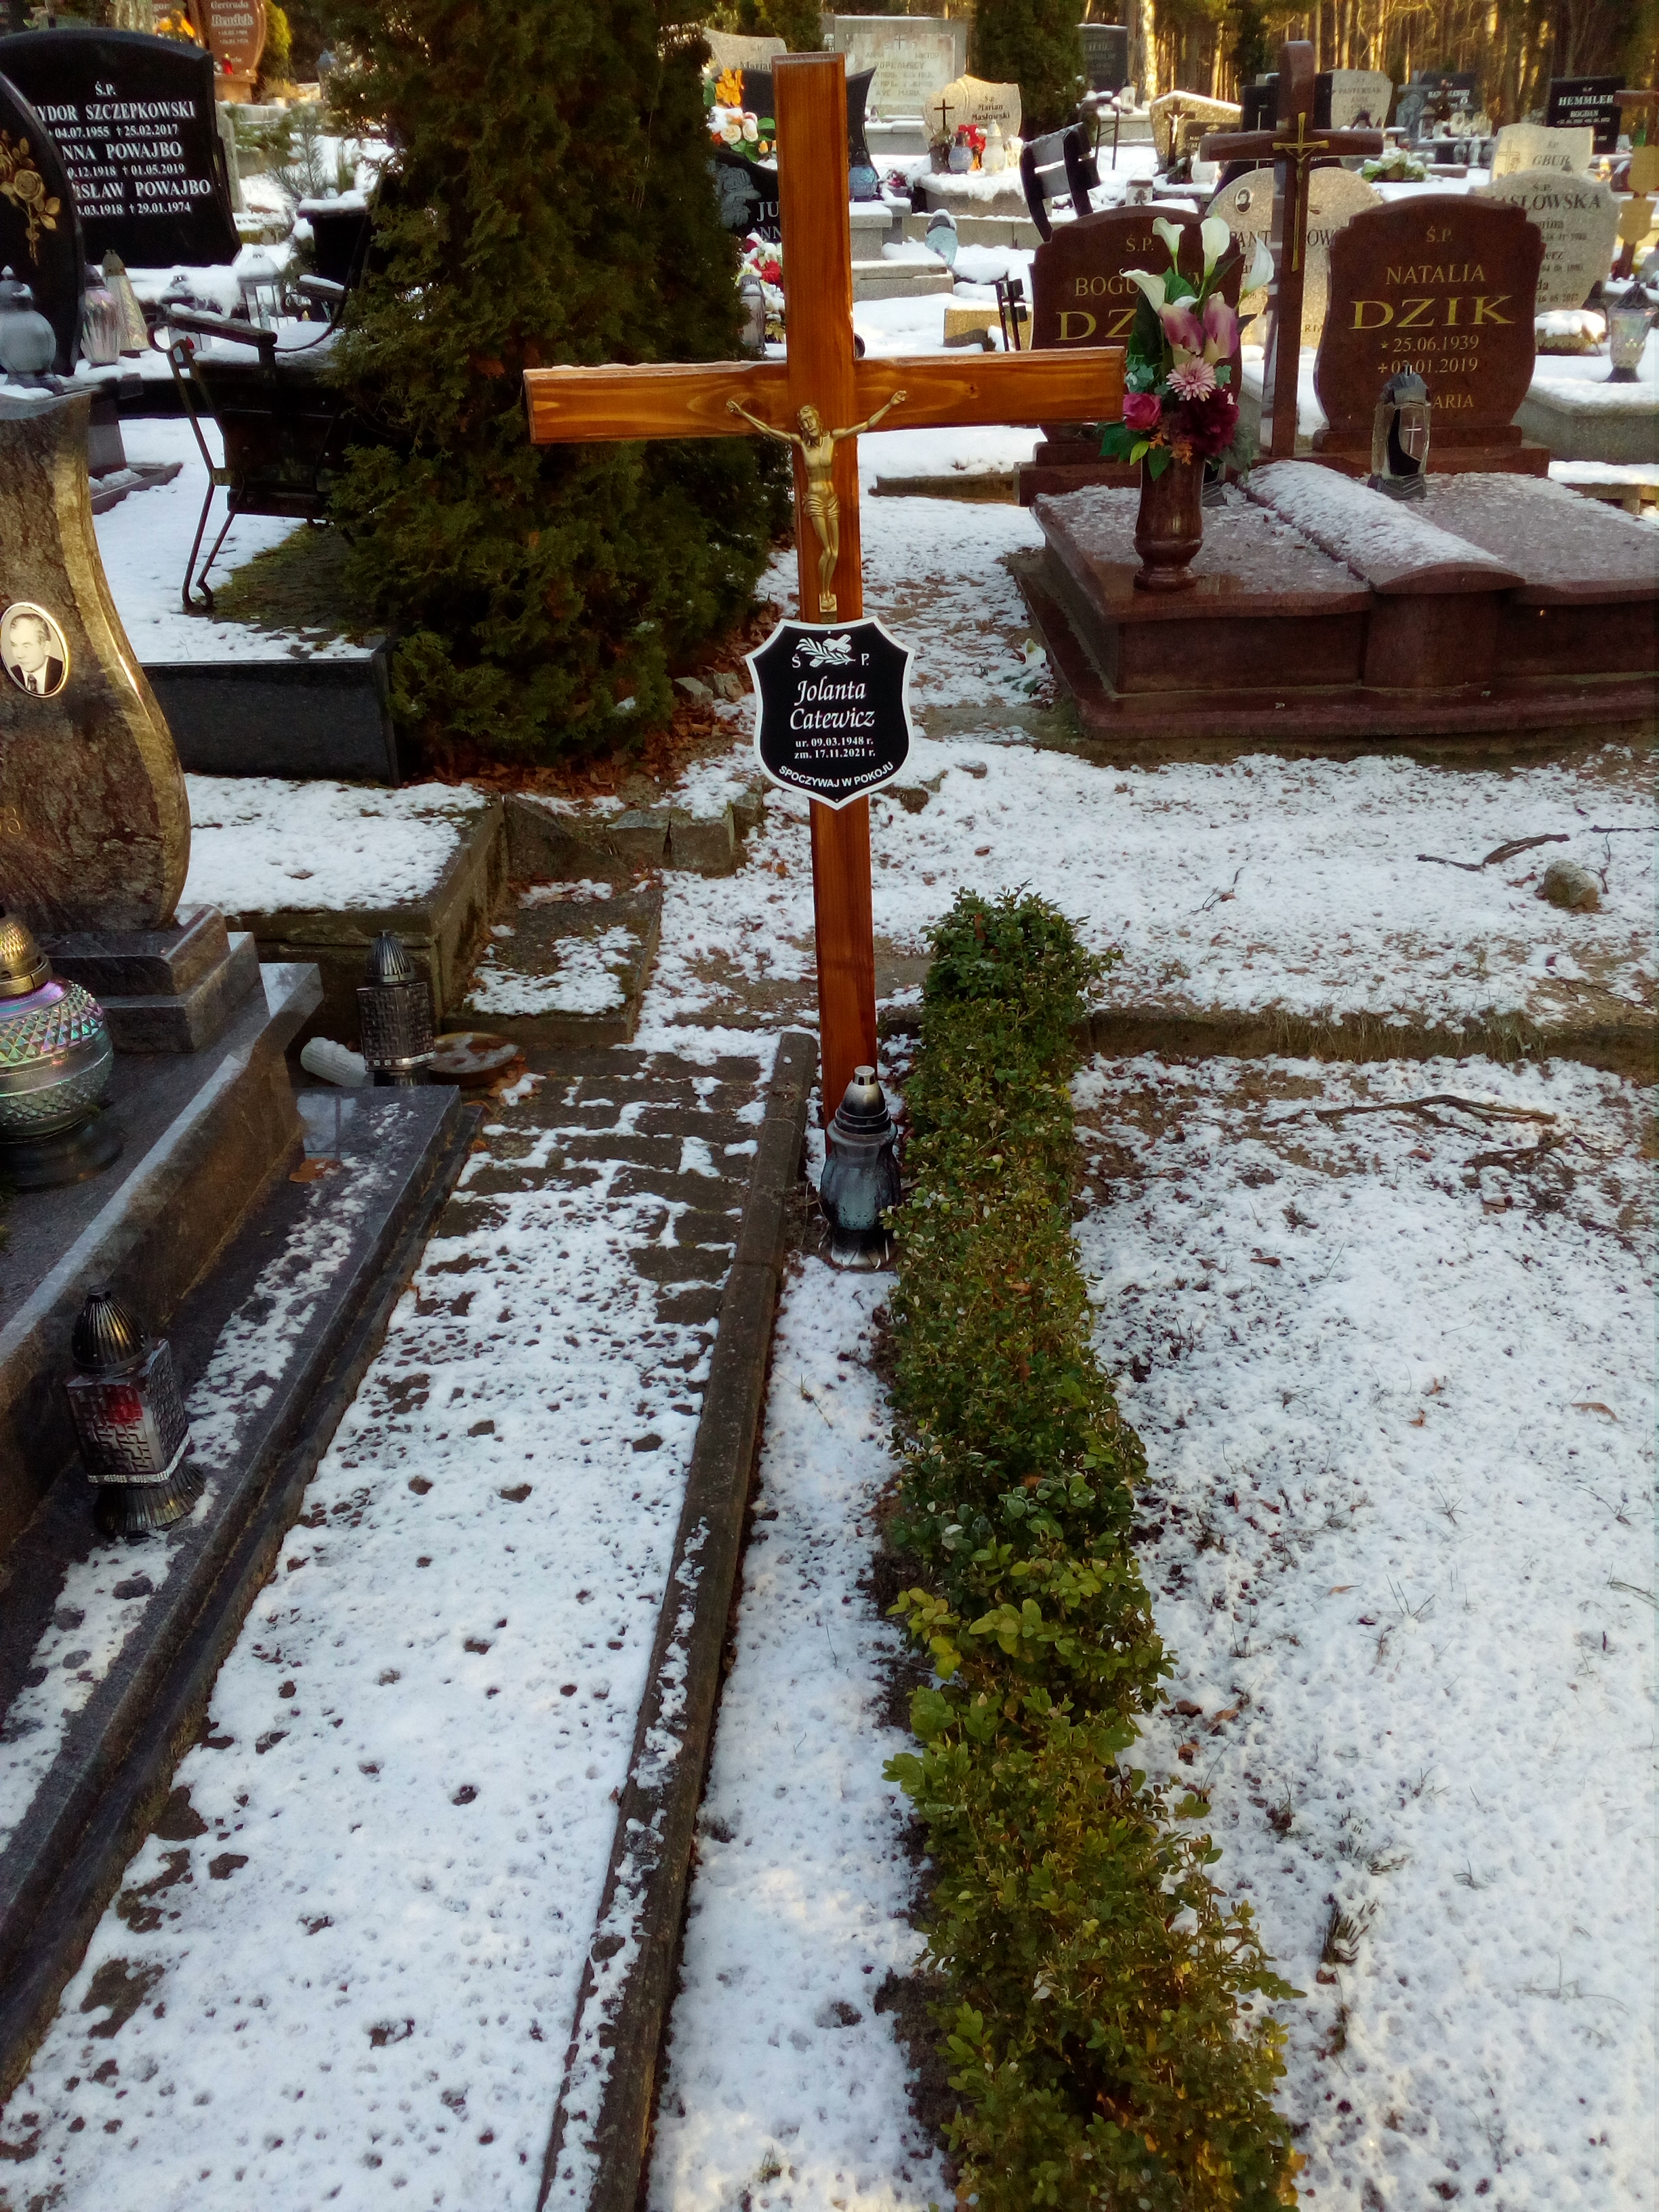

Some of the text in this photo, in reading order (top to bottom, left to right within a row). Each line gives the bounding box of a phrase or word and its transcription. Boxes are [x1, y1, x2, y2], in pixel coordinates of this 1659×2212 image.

[95, 81, 117, 96] Ś.P.
[1559, 95, 1614, 106] HEMMLER
[33, 101, 196, 121] YDOR SZCZEPKOWSKI
[125, 124, 178, 136] 25.02.2017
[62, 141, 183, 161] NNA POWAJBO
[131, 163, 185, 176] 01.05.2019
[135, 179, 211, 197] POWAJBO
[138, 201, 191, 214] 29.01.1974
[756, 201, 779, 222] JU
[1126, 234, 1153, 252] Ś.P.
[1386, 264, 1486, 285] NATALIA
[1349, 295, 1515, 329] DZIK
[1055, 308, 1138, 341] DZ
[1393, 335, 1479, 352] 25.06.1939
[1433, 394, 1475, 409] ARIA
[794, 676, 866, 706] Jolanta
[790, 707, 875, 730] Catewicz
[796, 739, 809, 747] ur.
[811, 736, 864, 747] 09.03.1948
[794, 751, 812, 759] zm.
[815, 749, 866, 758] 17.11.2021
[779, 761, 894, 787] SPOCZYWAJ W POKOJU
